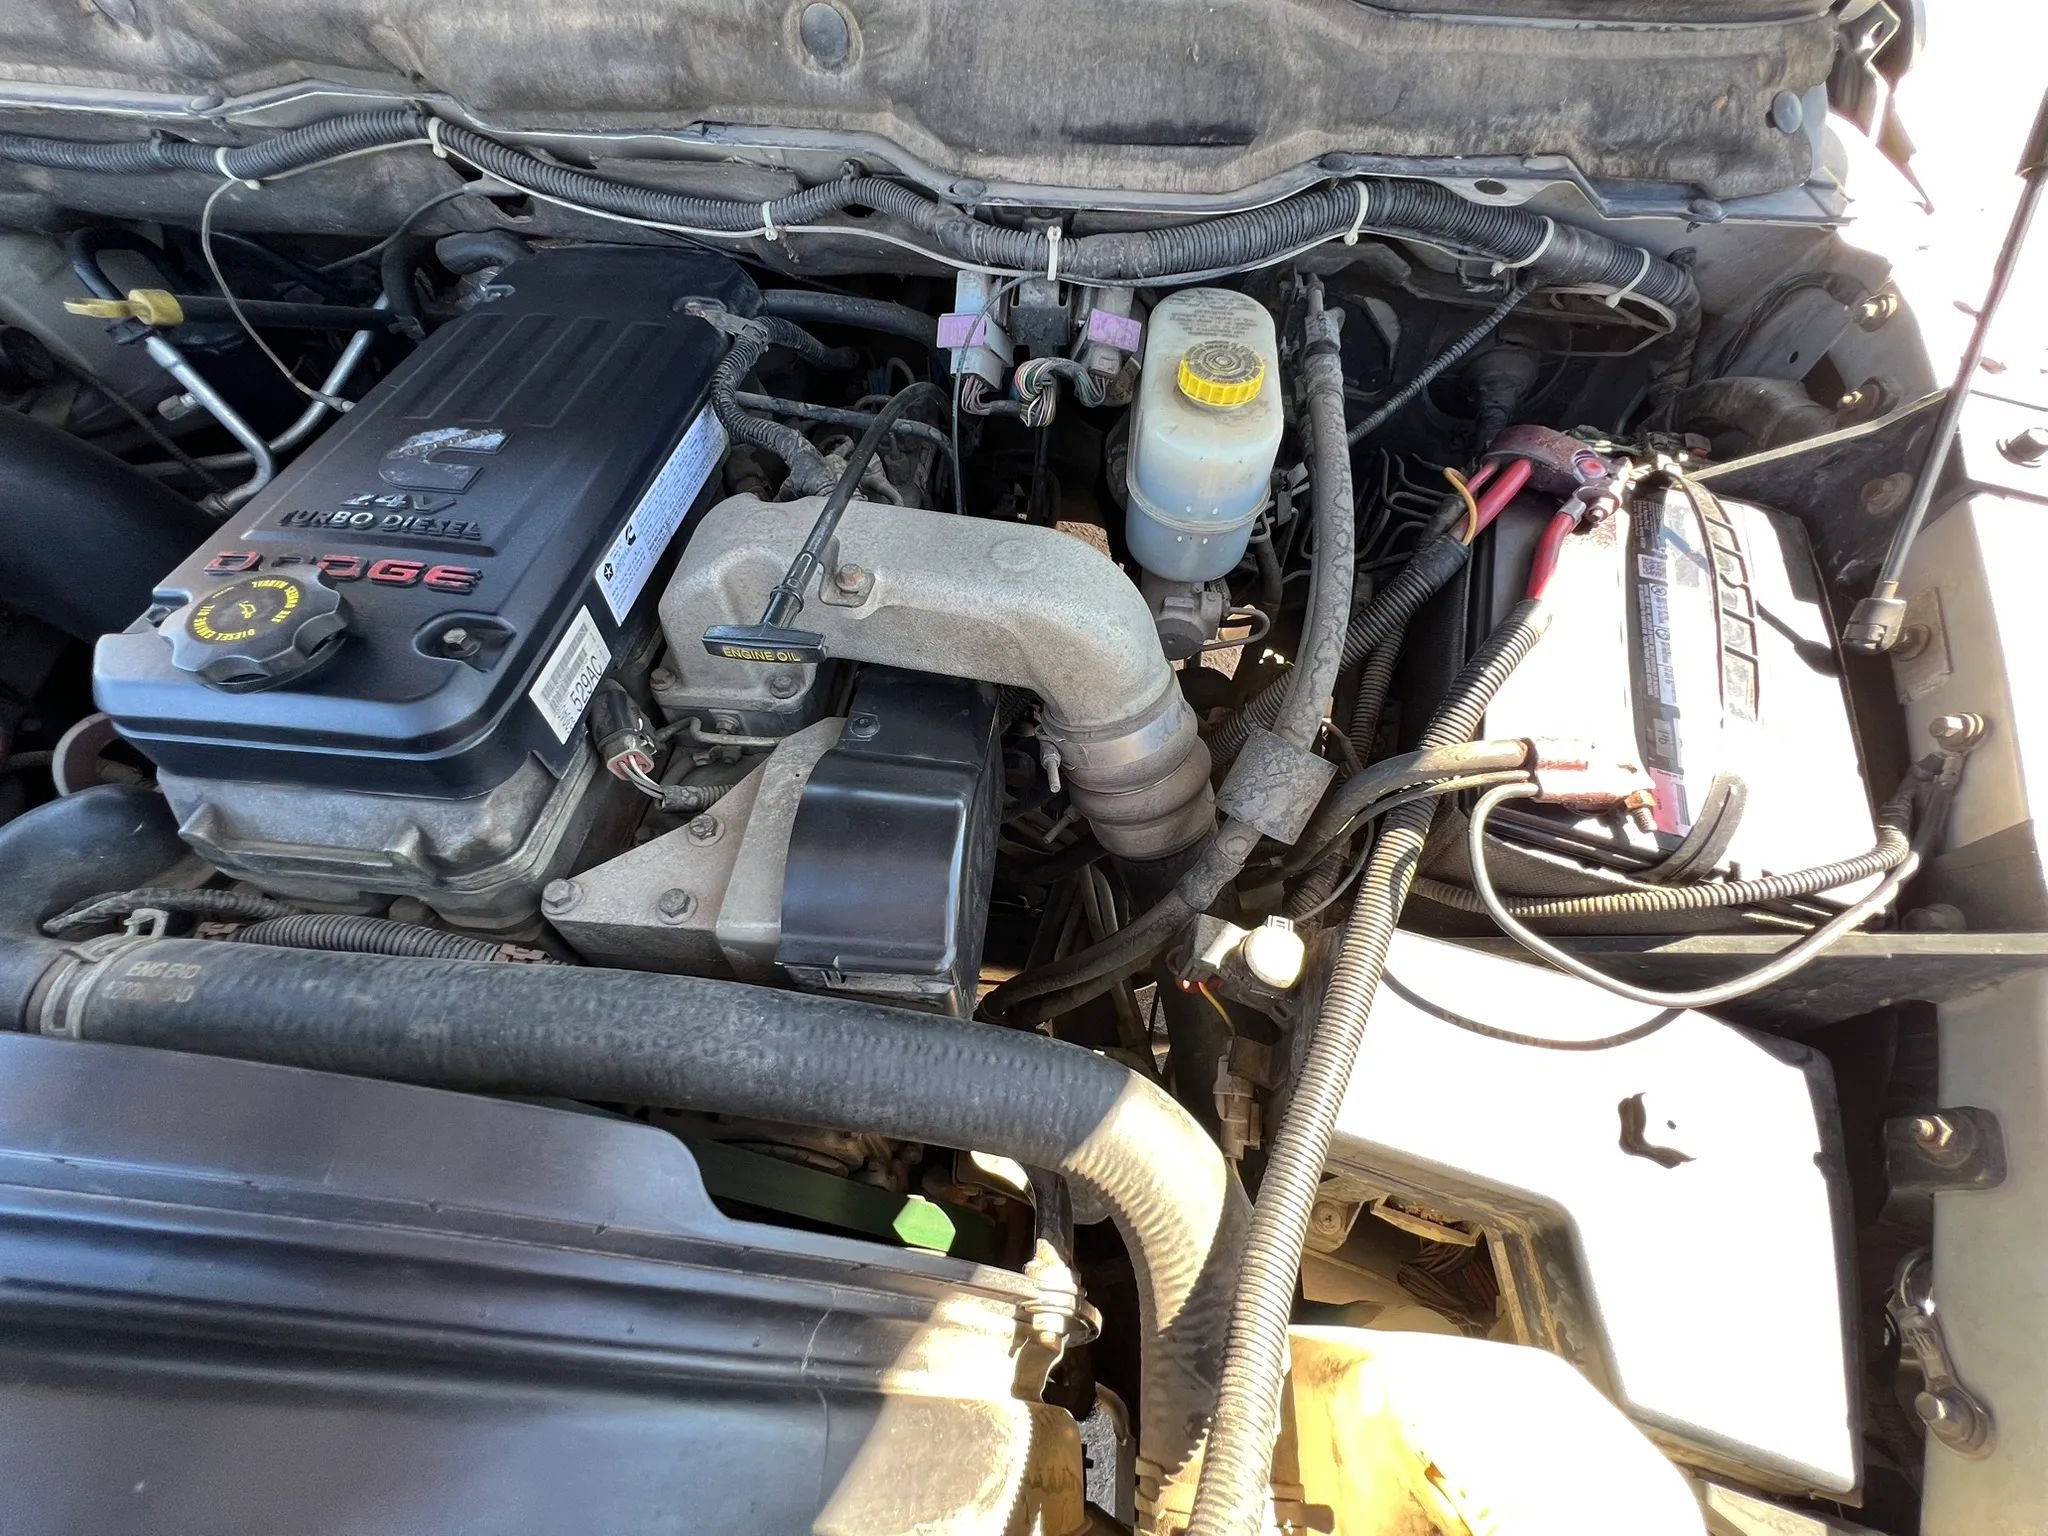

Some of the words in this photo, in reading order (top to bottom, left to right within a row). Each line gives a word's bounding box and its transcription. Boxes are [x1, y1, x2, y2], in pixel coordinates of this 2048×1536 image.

[277, 510, 375, 530] TURBO
[380, 514, 483, 541] DIESEL
[215, 628, 256, 641] DIESEL
[722, 647, 775, 661] ENGINE
[776, 651, 801, 662] OIL
[570, 655, 603, 713] 529AC
